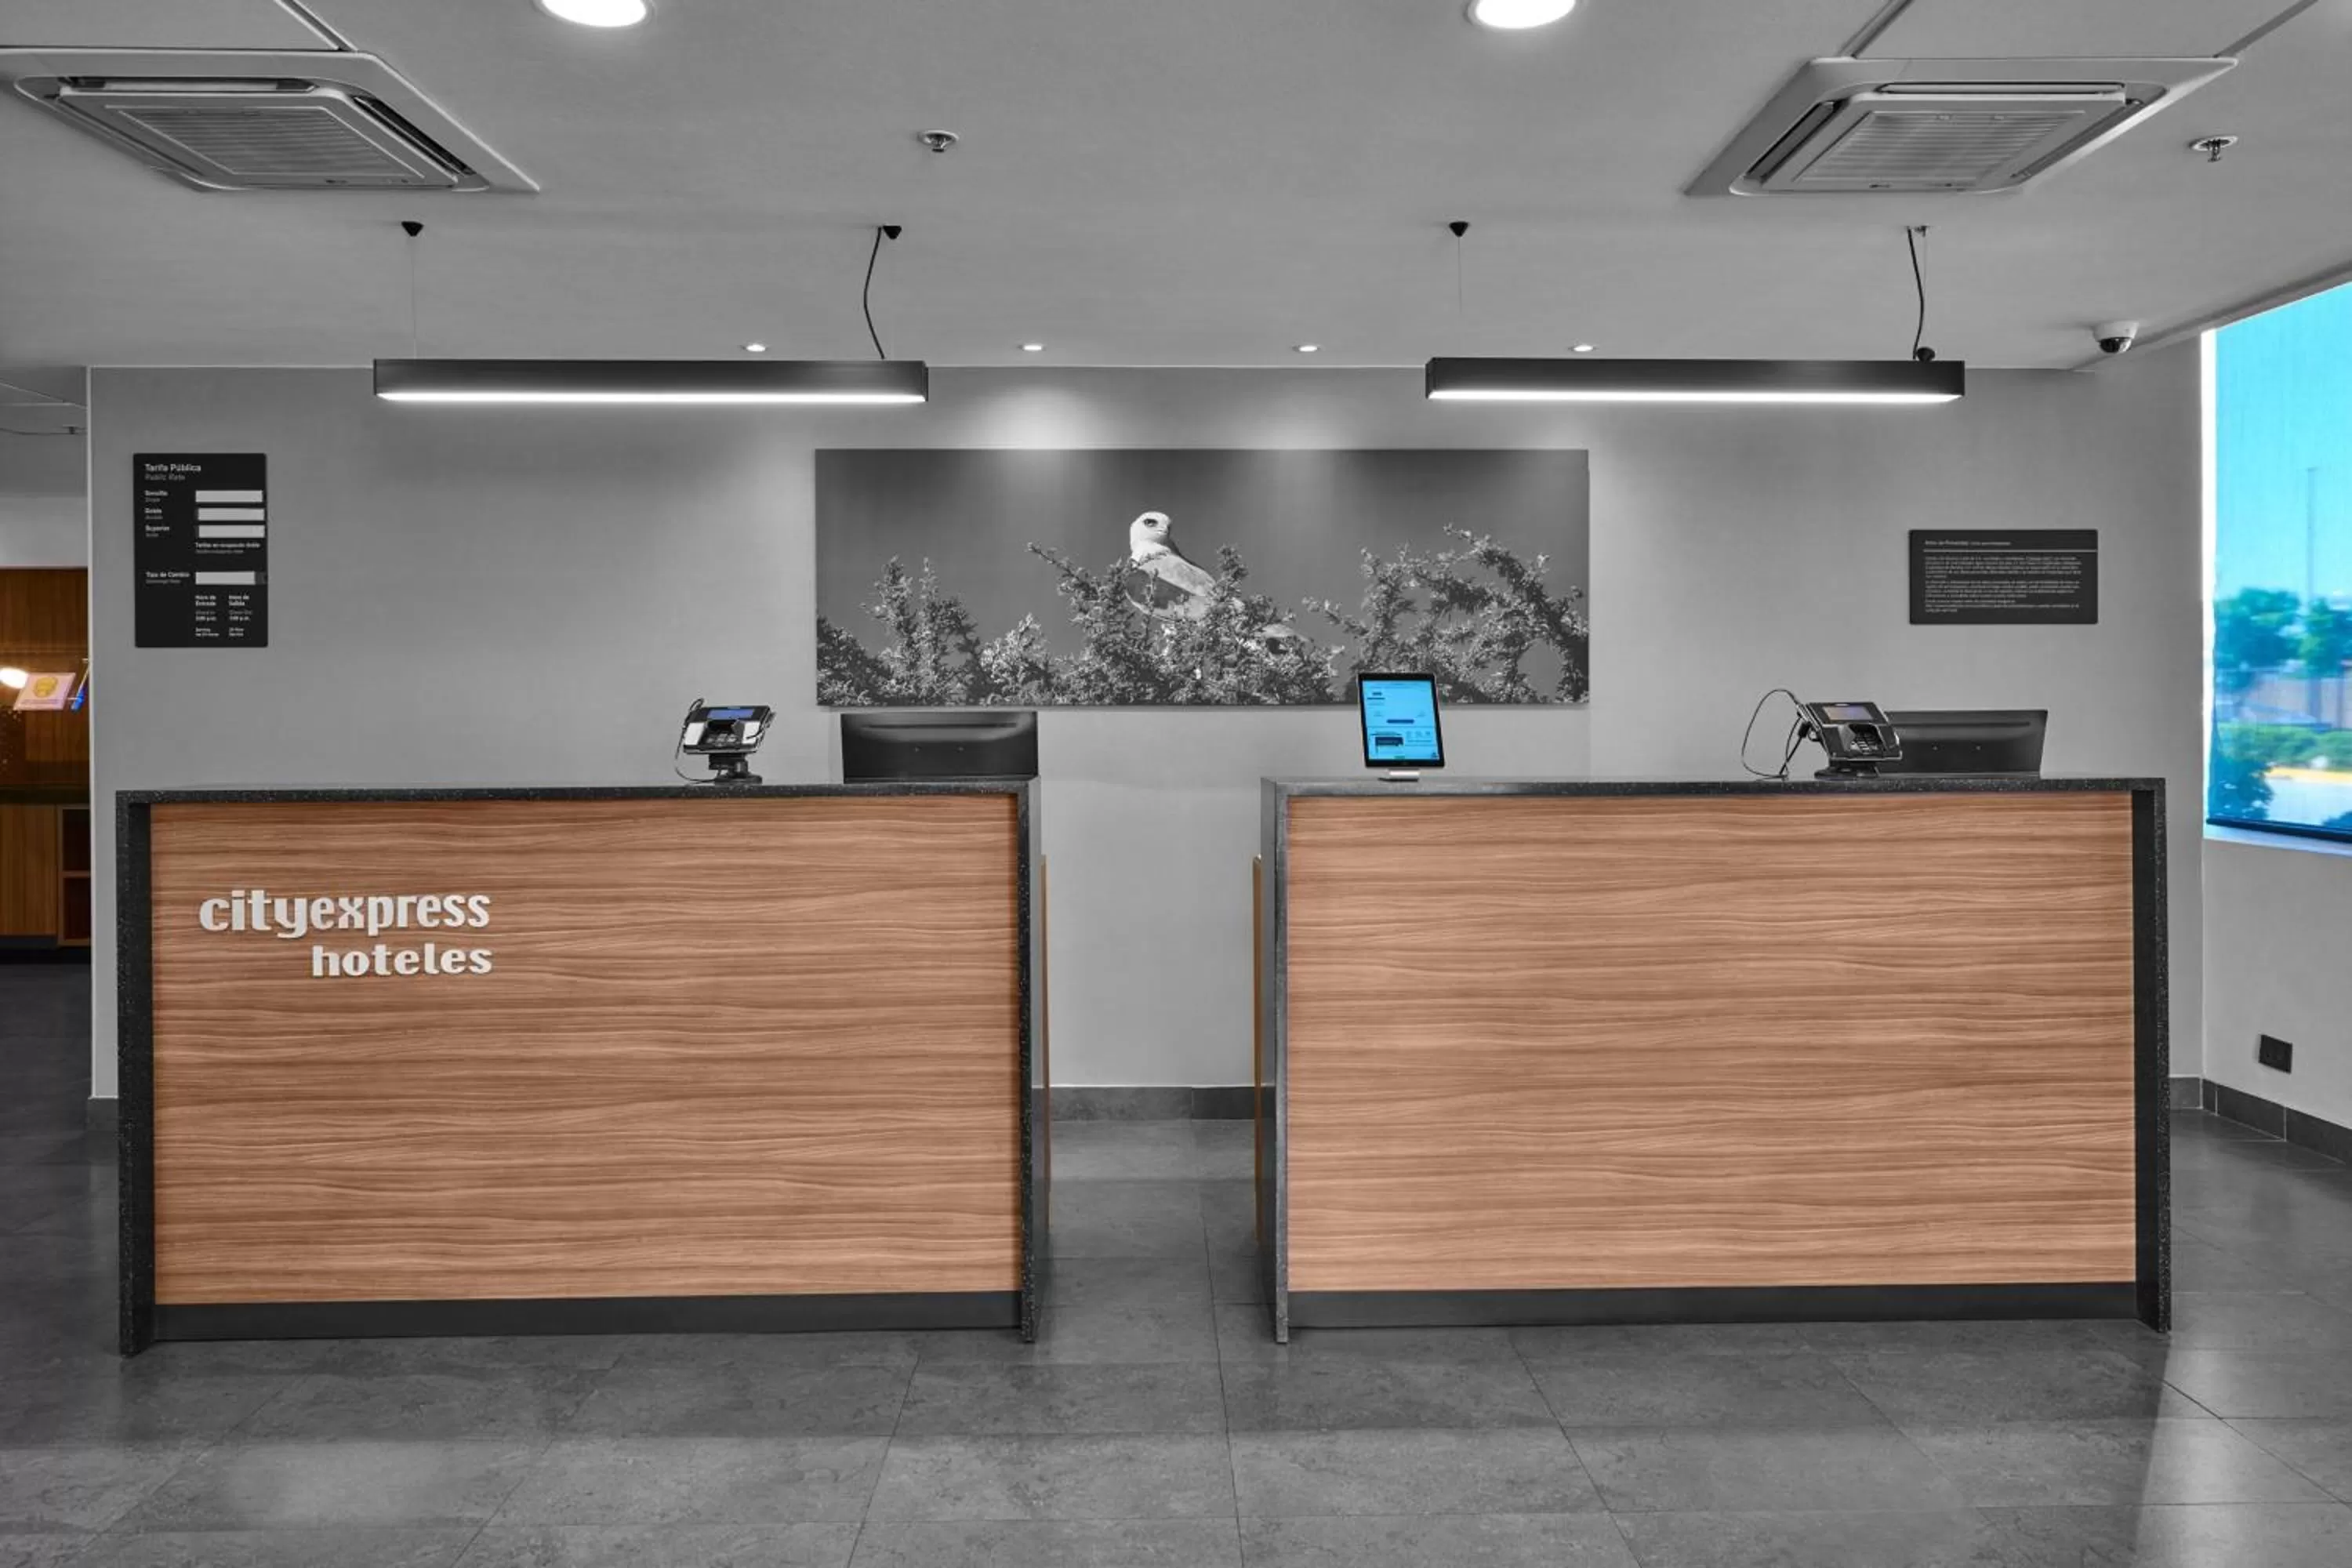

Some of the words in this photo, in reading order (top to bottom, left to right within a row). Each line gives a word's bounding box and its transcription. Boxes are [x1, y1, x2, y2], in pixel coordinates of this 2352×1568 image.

[144, 463, 169, 472] Tarifa
[170, 463, 201, 472] Pública
[199, 890, 491, 938] cityexpress
[312, 943, 493, 977] hoteles
